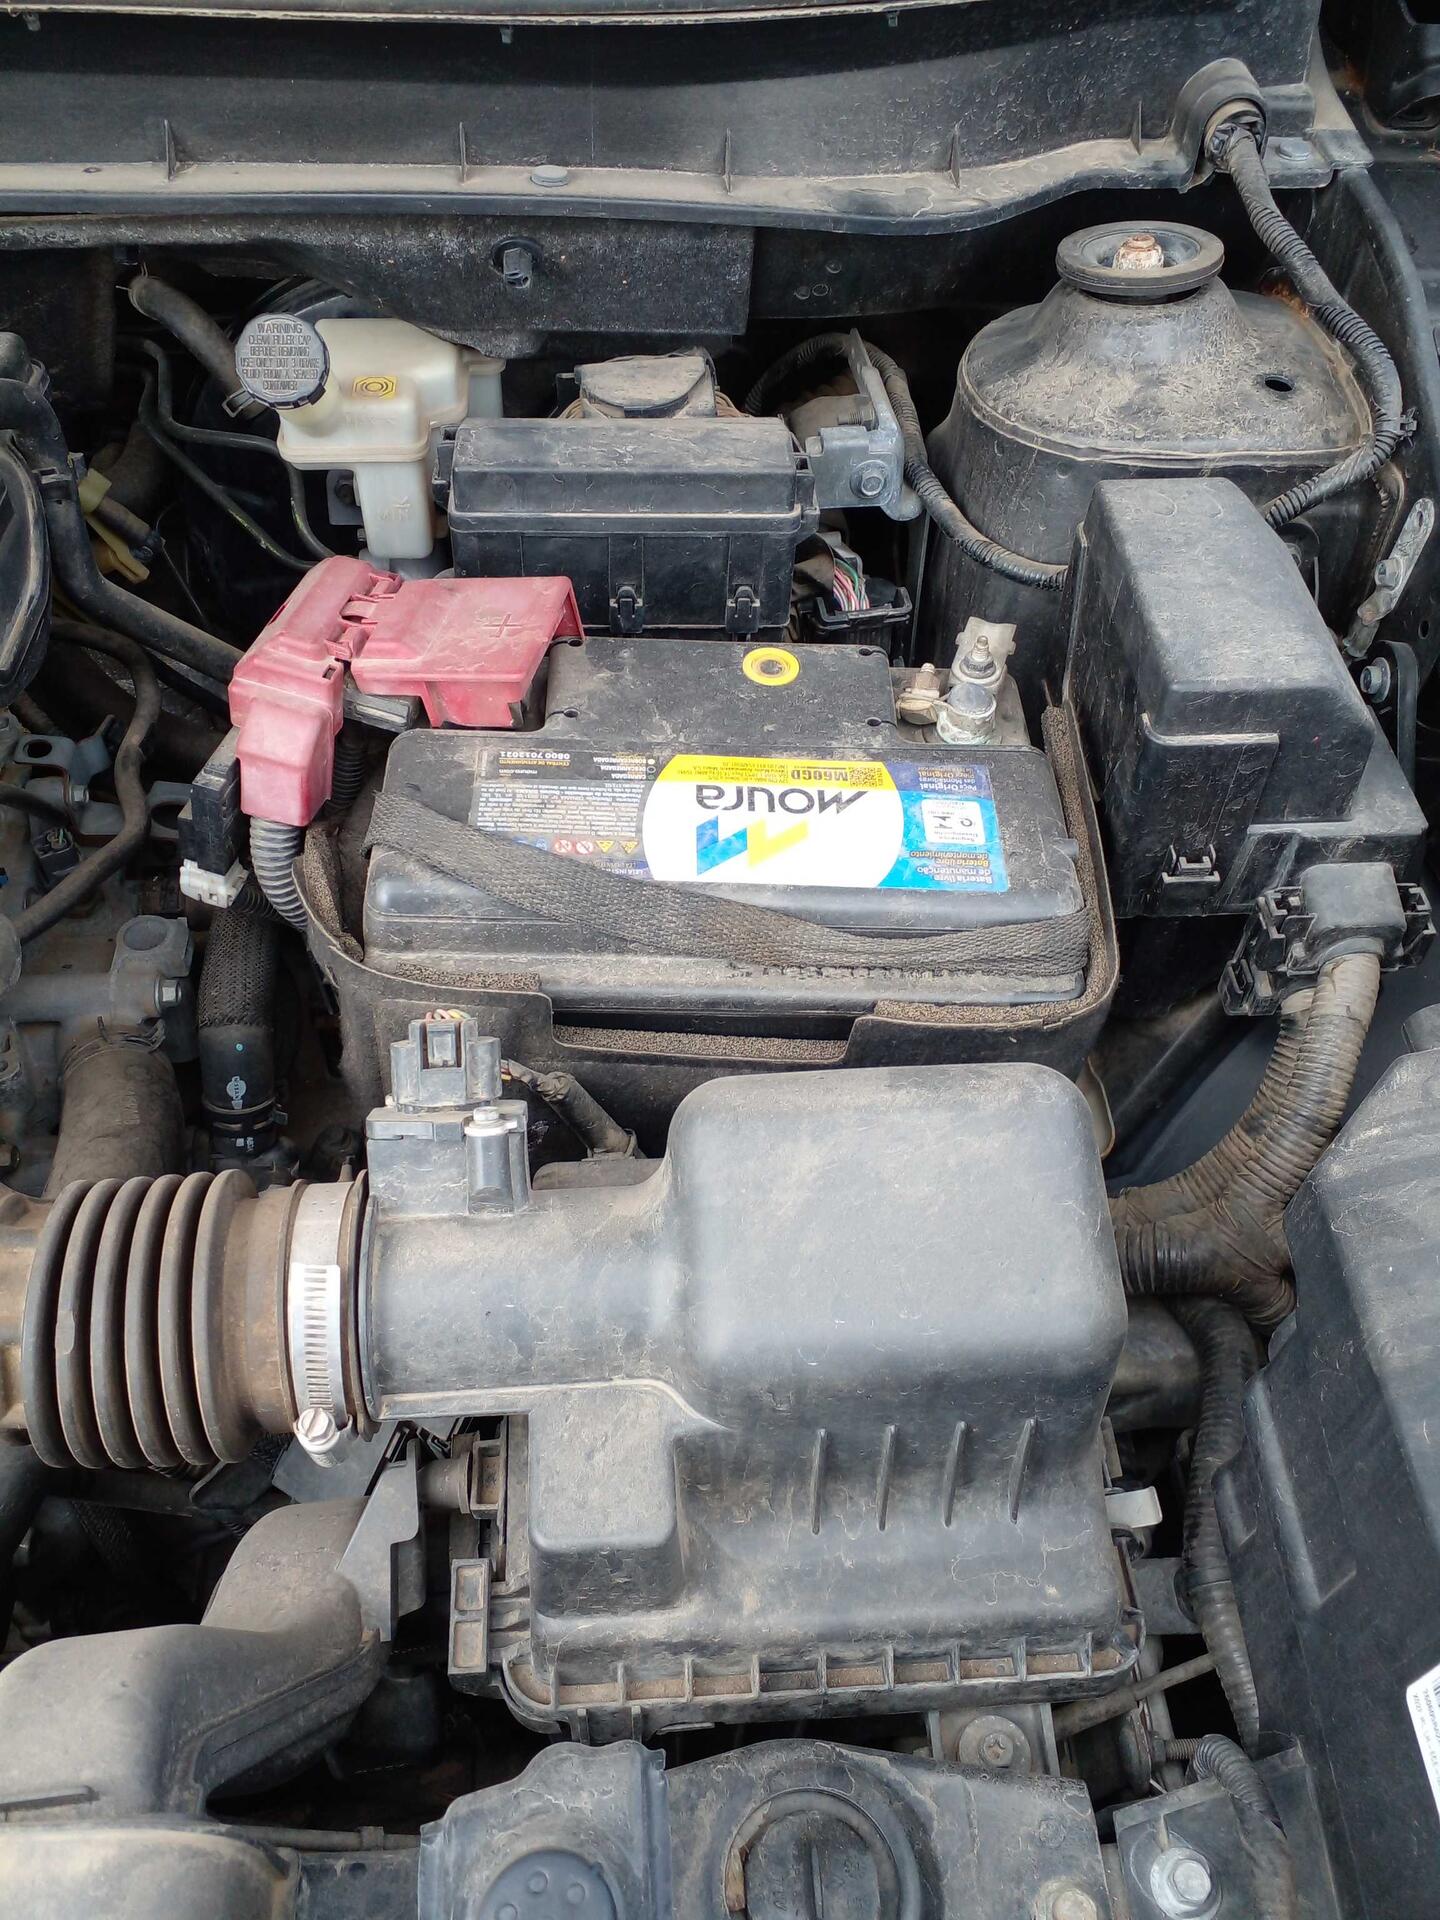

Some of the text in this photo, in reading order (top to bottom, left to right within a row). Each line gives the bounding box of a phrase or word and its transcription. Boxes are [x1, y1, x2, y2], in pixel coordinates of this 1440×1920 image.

[257, 323, 302, 333] WARNING
[249, 335, 311, 345] CLEAN FILLER CAP
[240, 358, 253, 367] USE
[256, 358, 273, 367] ONLY
[277, 358, 288, 367] DOT
[263, 381, 298, 390] CONTAINER
[790, 769, 849, 782] M60GD
[917, 865, 976, 874] manutenção
